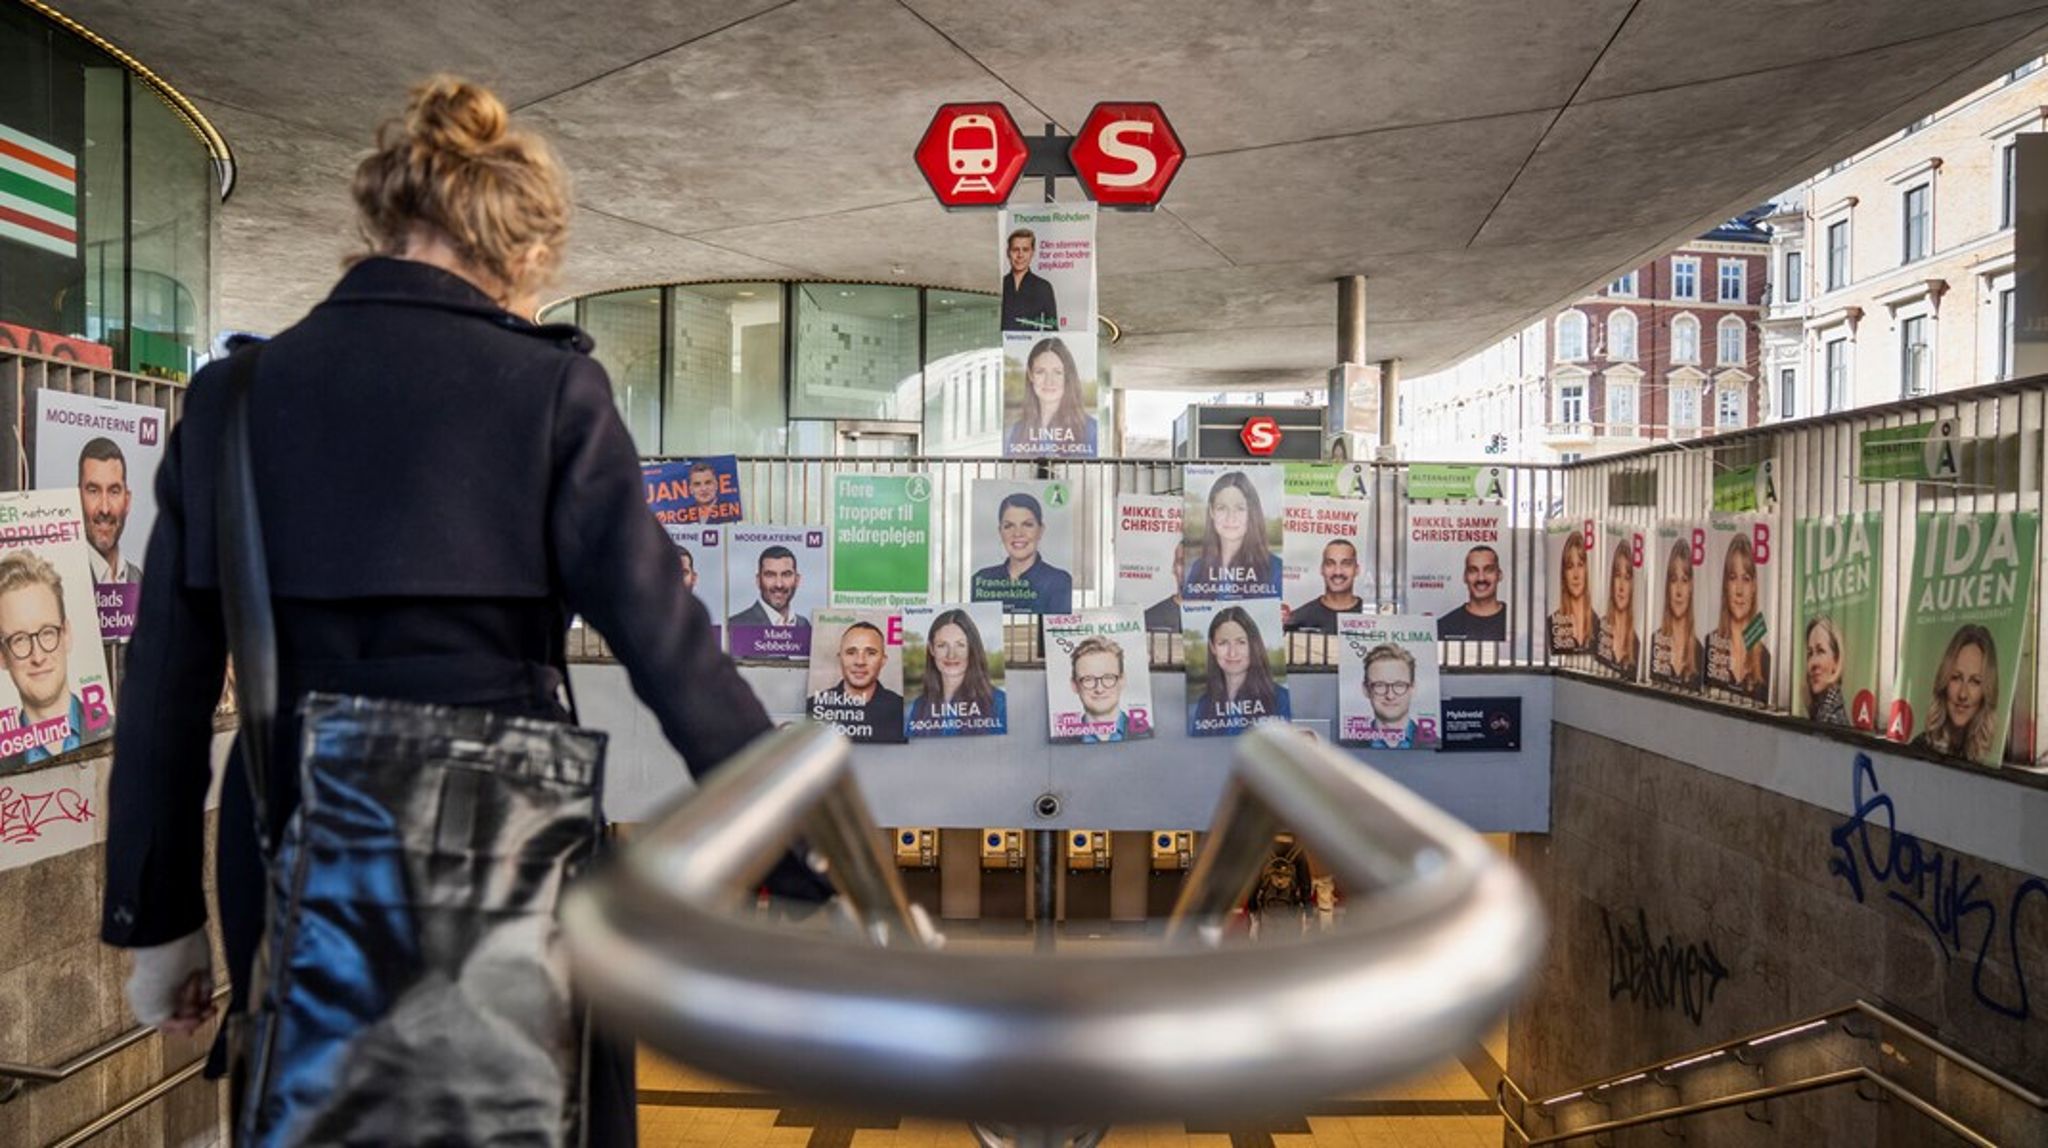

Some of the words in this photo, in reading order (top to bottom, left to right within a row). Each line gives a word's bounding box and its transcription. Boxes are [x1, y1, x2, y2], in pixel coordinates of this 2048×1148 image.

[1096, 119, 1157, 187] S
[1013, 213, 1051, 223] Thomas
[1052, 211, 1090, 222] Rohden
[46, 408, 135, 433] MODERATERNE
[141, 421, 156, 441] M
[1029, 427, 1074, 441] LINEA
[1251, 422, 1275, 448] S
[1010, 442, 1093, 453] SØGAARD-LIDELL
[646, 479, 689, 504] JAN
[719, 474, 738, 494] E.
[839, 480, 874, 498] Flere
[22, 505, 71, 519] naturen
[656, 502, 741, 523] ØRGENSEN
[840, 504, 893, 525] tropper
[898, 503, 914, 521] til
[1122, 506, 1165, 519] MIKKEL
[1285, 507, 1313, 519] KKEL
[1316, 509, 1358, 522] SAMMY
[1121, 518, 1183, 532] CHRISTEN
[1283, 520, 1358, 536] RISTENSEN
[1412, 516, 1455, 528] MIKKEL
[1456, 517, 1498, 528] SAMMY
[704, 533, 717, 544] M
[735, 533, 803, 543] MODERATERNE
[808, 534, 821, 545] M
[838, 526, 925, 547] ældreplejen
[1412, 529, 1498, 542] CHRISTENSEN
[1584, 519, 1595, 550] B
[1632, 533, 1644, 567] B
[1692, 528, 1705, 567] B
[1753, 523, 1770, 564] B
[1805, 516, 1871, 576] IDA
[1923, 512, 2019, 579] IDA
[1209, 567, 1257, 582] LINEA
[1804, 560, 1870, 605] AUKEN
[975, 588, 1038, 600] Rosenkilde
[1187, 583, 1278, 594] SØGAARD-LIDELL
[1918, 570, 2018, 613] AUKEN
[100, 610, 135, 628] belov
[764, 628, 793, 639] Mads
[1052, 624, 1094, 637] ELLER
[1098, 622, 1141, 634] KLIMA
[1346, 630, 1387, 641] ELLER
[1391, 631, 1434, 642] KLIMA
[753, 639, 801, 651] Sebbelov
[814, 690, 867, 706] Mikkel
[81, 683, 109, 732] B
[813, 706, 865, 721] Senna
[931, 702, 981, 717] LINEA
[1216, 700, 1266, 716] LINEA
[1857, 702, 1870, 723] A
[909, 718, 1003, 730] SØGAARD-LIDELL
[1127, 708, 1149, 733] B
[1195, 715, 1286, 731] SØGAARD-L
[1890, 712, 1904, 735] A
[0, 716, 71, 757] oselund
[814, 721, 873, 737] doom
[1344, 728, 1406, 740] Moselund
[1417, 718, 1437, 743] B
